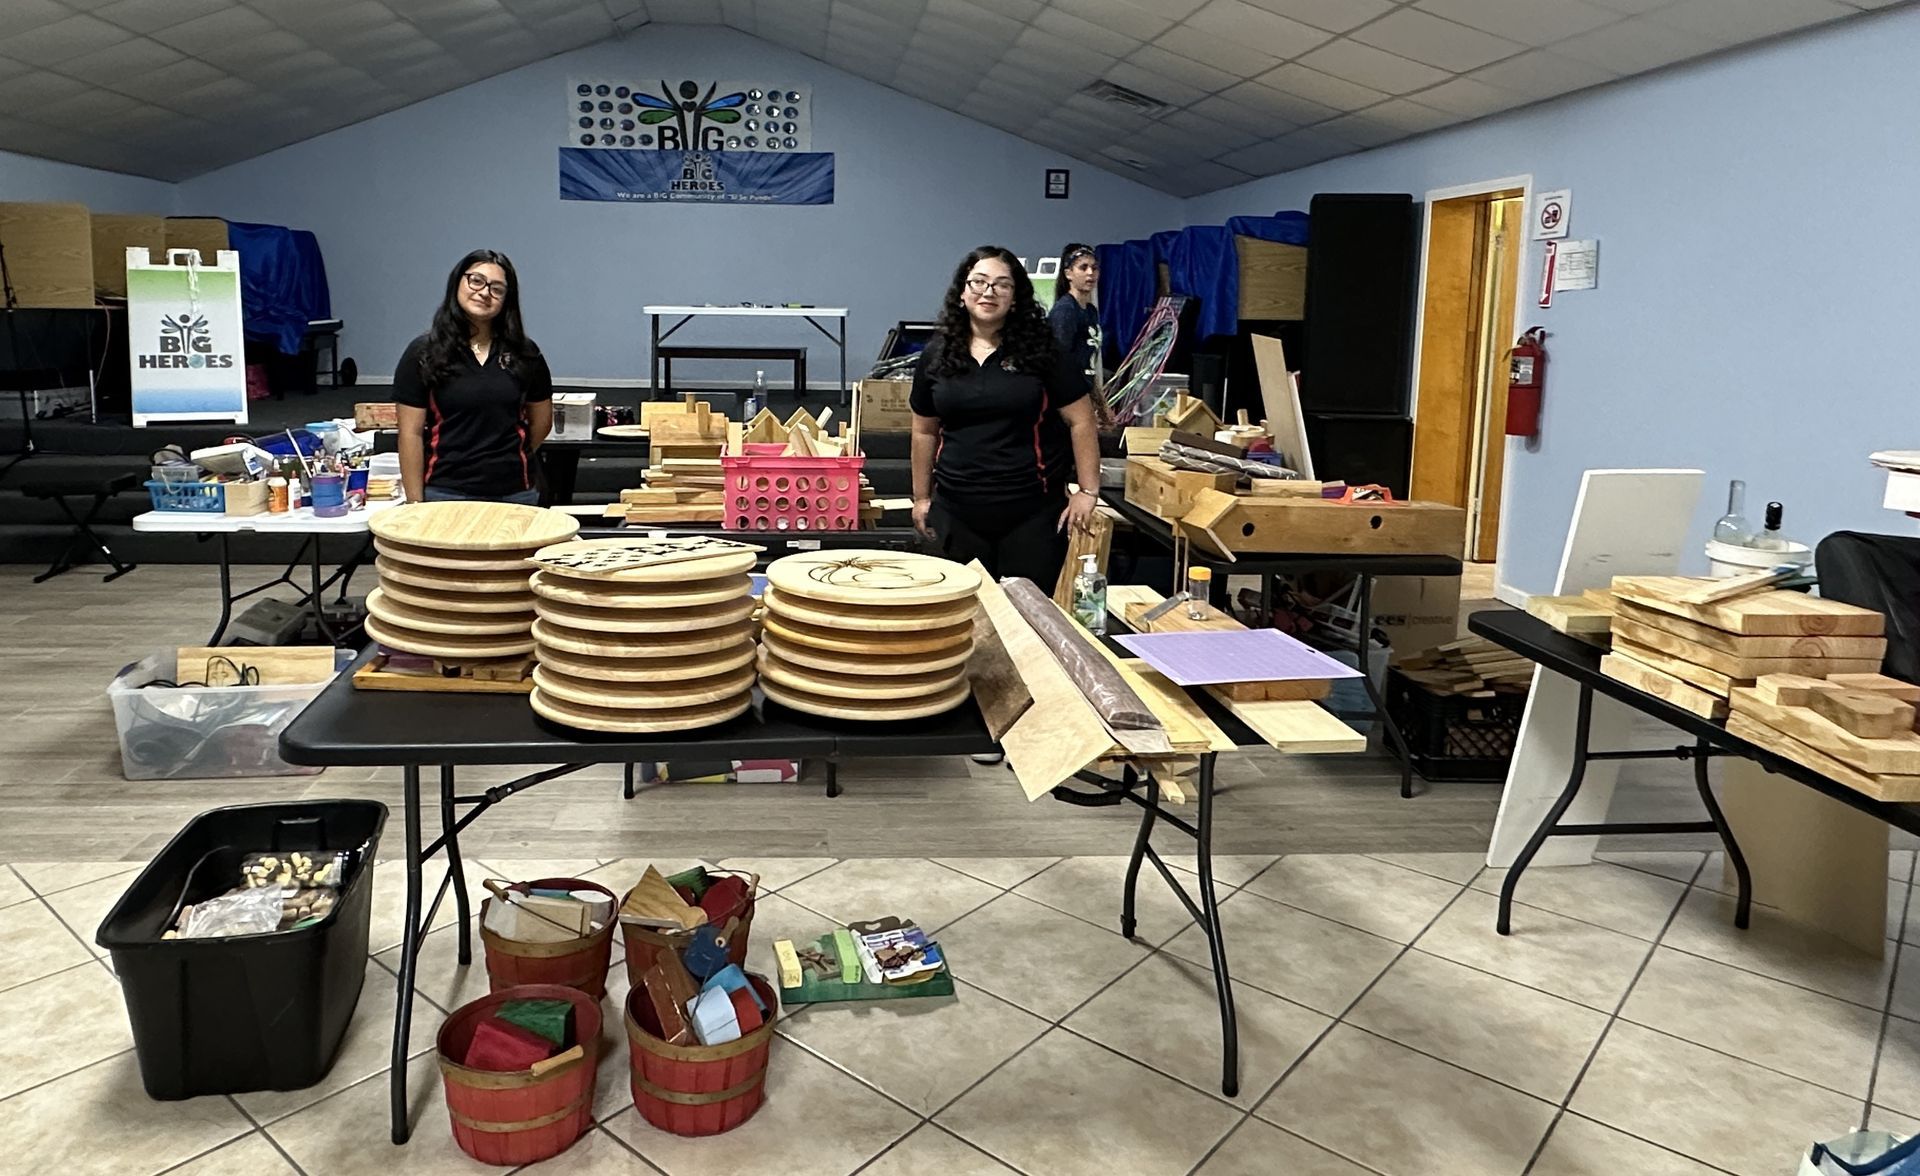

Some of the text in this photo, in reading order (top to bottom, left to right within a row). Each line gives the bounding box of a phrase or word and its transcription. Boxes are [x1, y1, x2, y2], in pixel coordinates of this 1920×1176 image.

[657, 126, 724, 151] BIG
[683, 168, 712, 180] BIG
[671, 181, 725, 190] HEROES
[616, 191, 630, 199] We
[160, 336, 212, 354] BIG
[139, 354, 233, 369] HEROES
